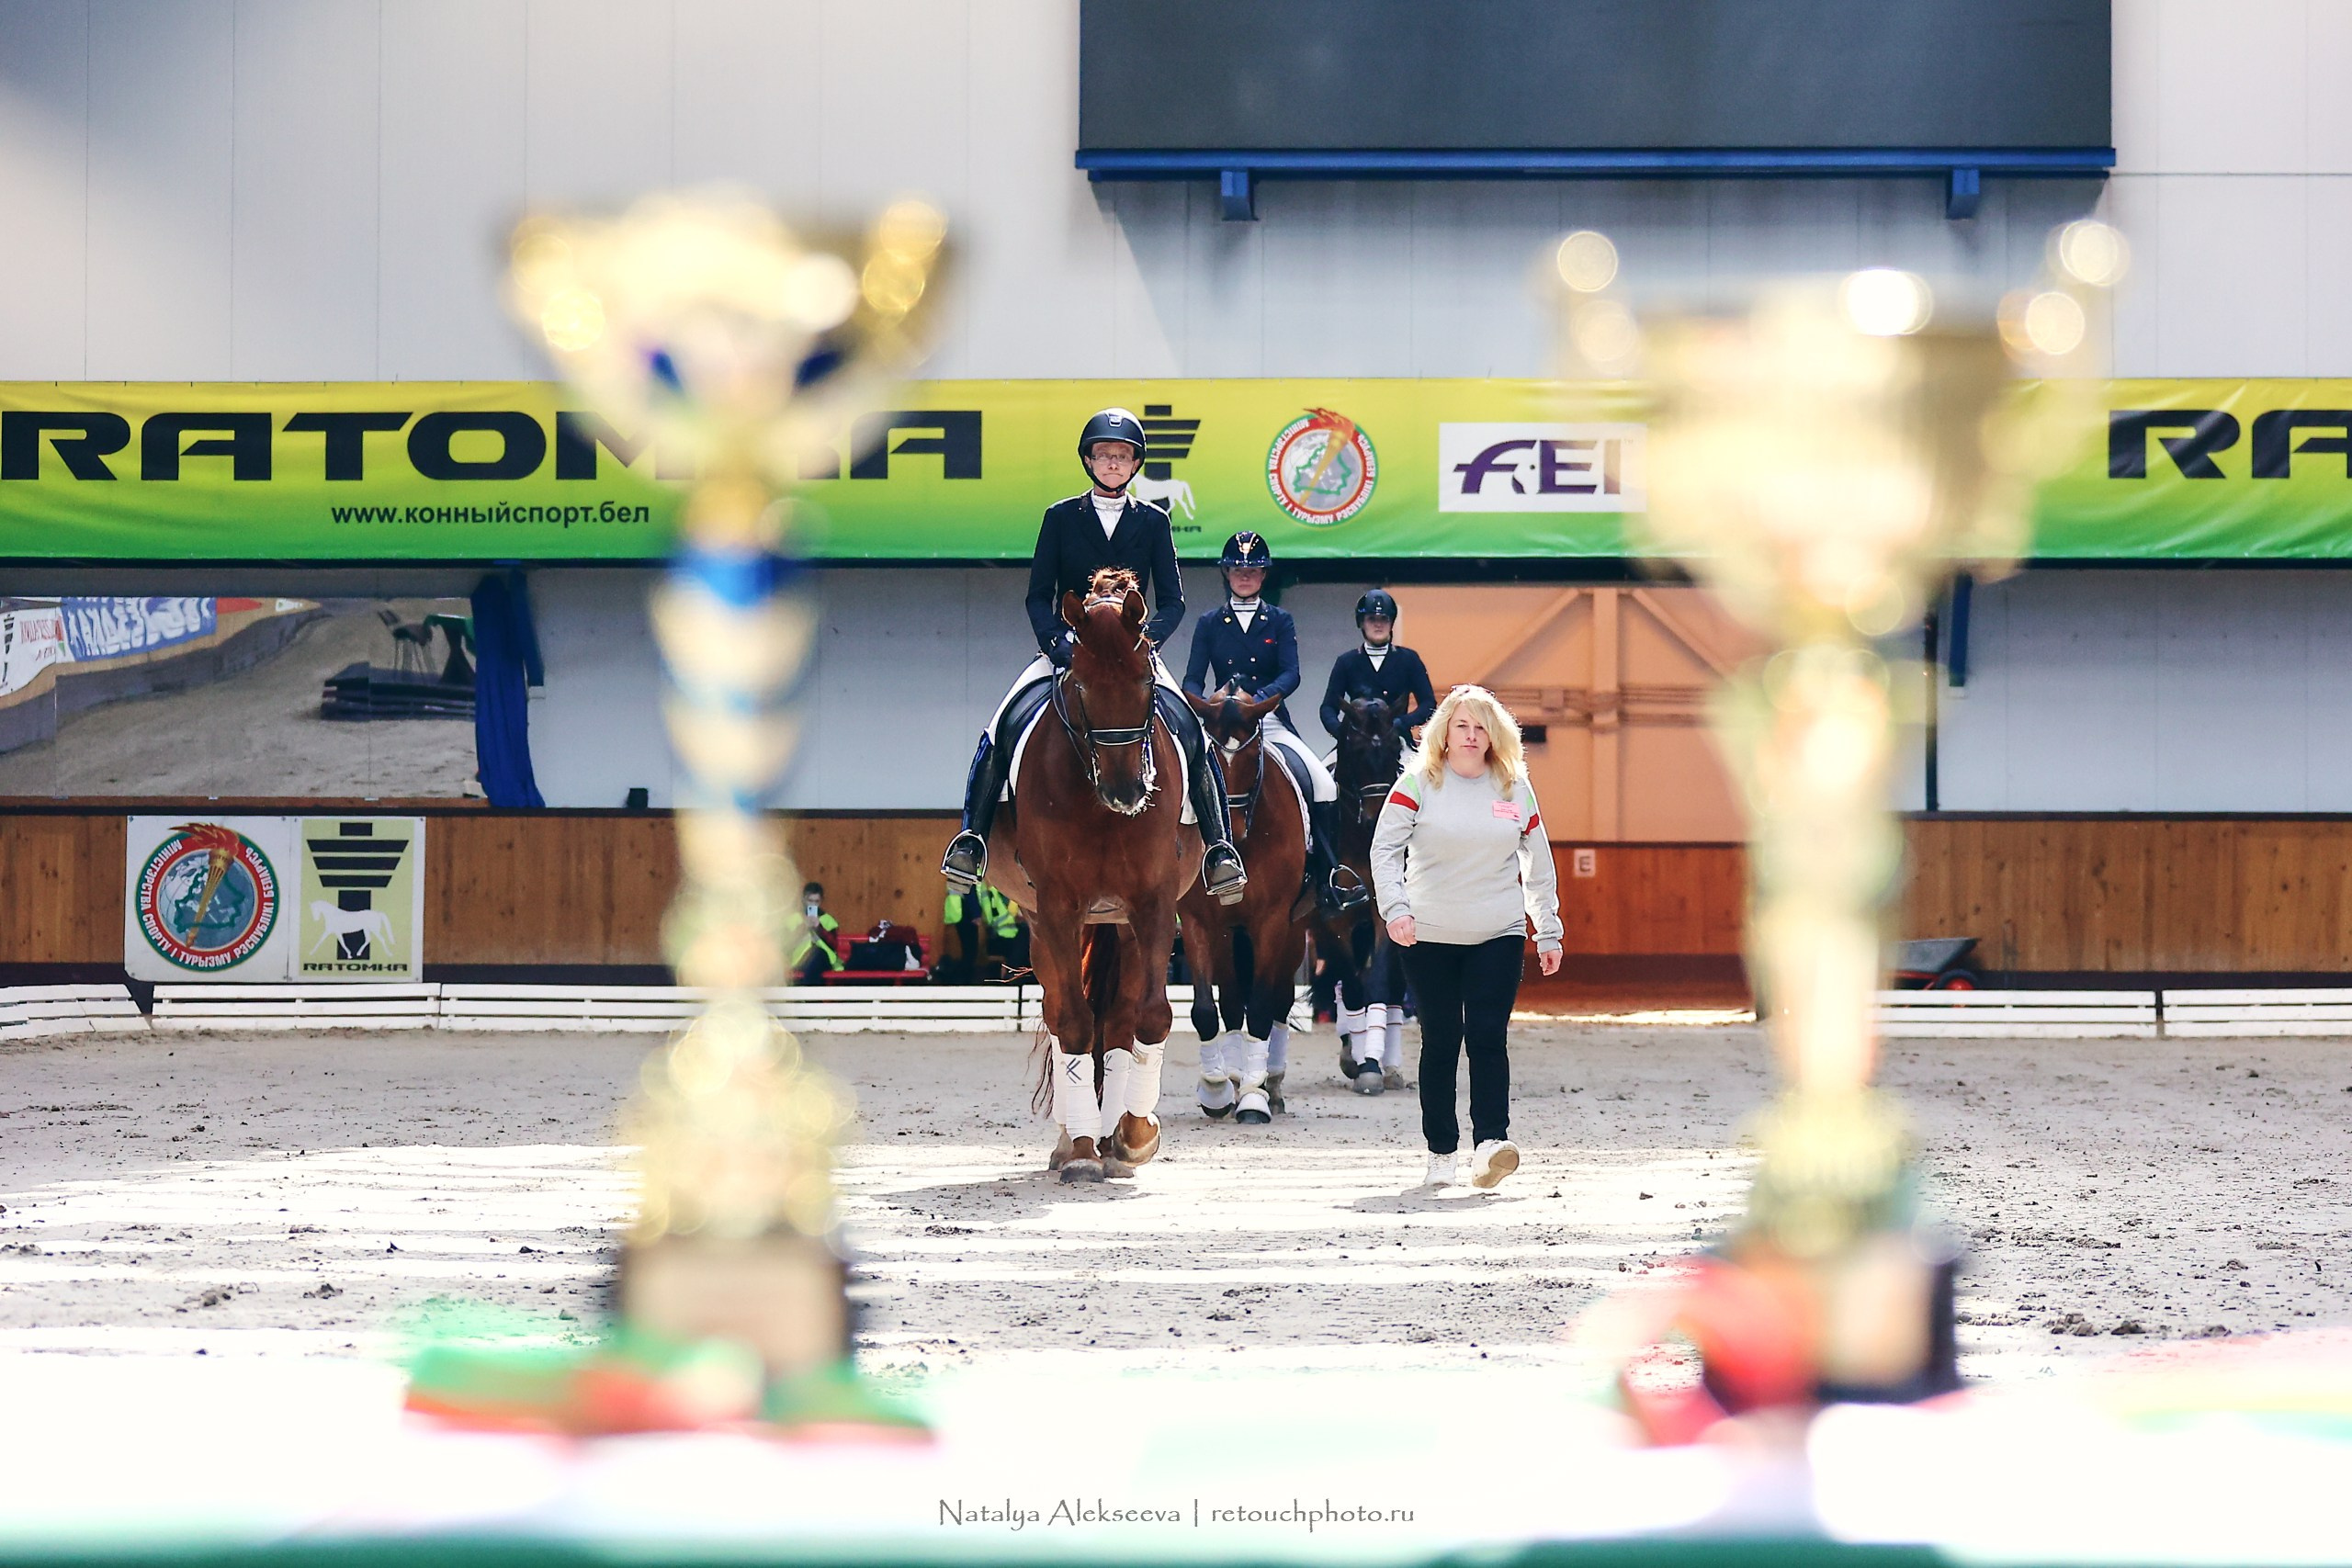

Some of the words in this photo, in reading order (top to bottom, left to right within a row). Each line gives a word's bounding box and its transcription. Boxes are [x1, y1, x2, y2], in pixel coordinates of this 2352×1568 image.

[2, 411, 982, 480] RATOMA
[1453, 439, 1621, 495] FEI
[331, 502, 649, 528] www.конныйспорт.бел
[141, 839, 183, 911] МІНІСТЭРСТВА
[245, 847, 275, 898] БЕЛАРУСЬ
[1578, 855, 1591, 872] E
[142, 913, 173, 951] СПОРТУ
[233, 901, 275, 959] РЭСПУБЛІКІ
[178, 951, 232, 968] ТУРЫЗМУ
[303, 963, 408, 972] RATOMKA
